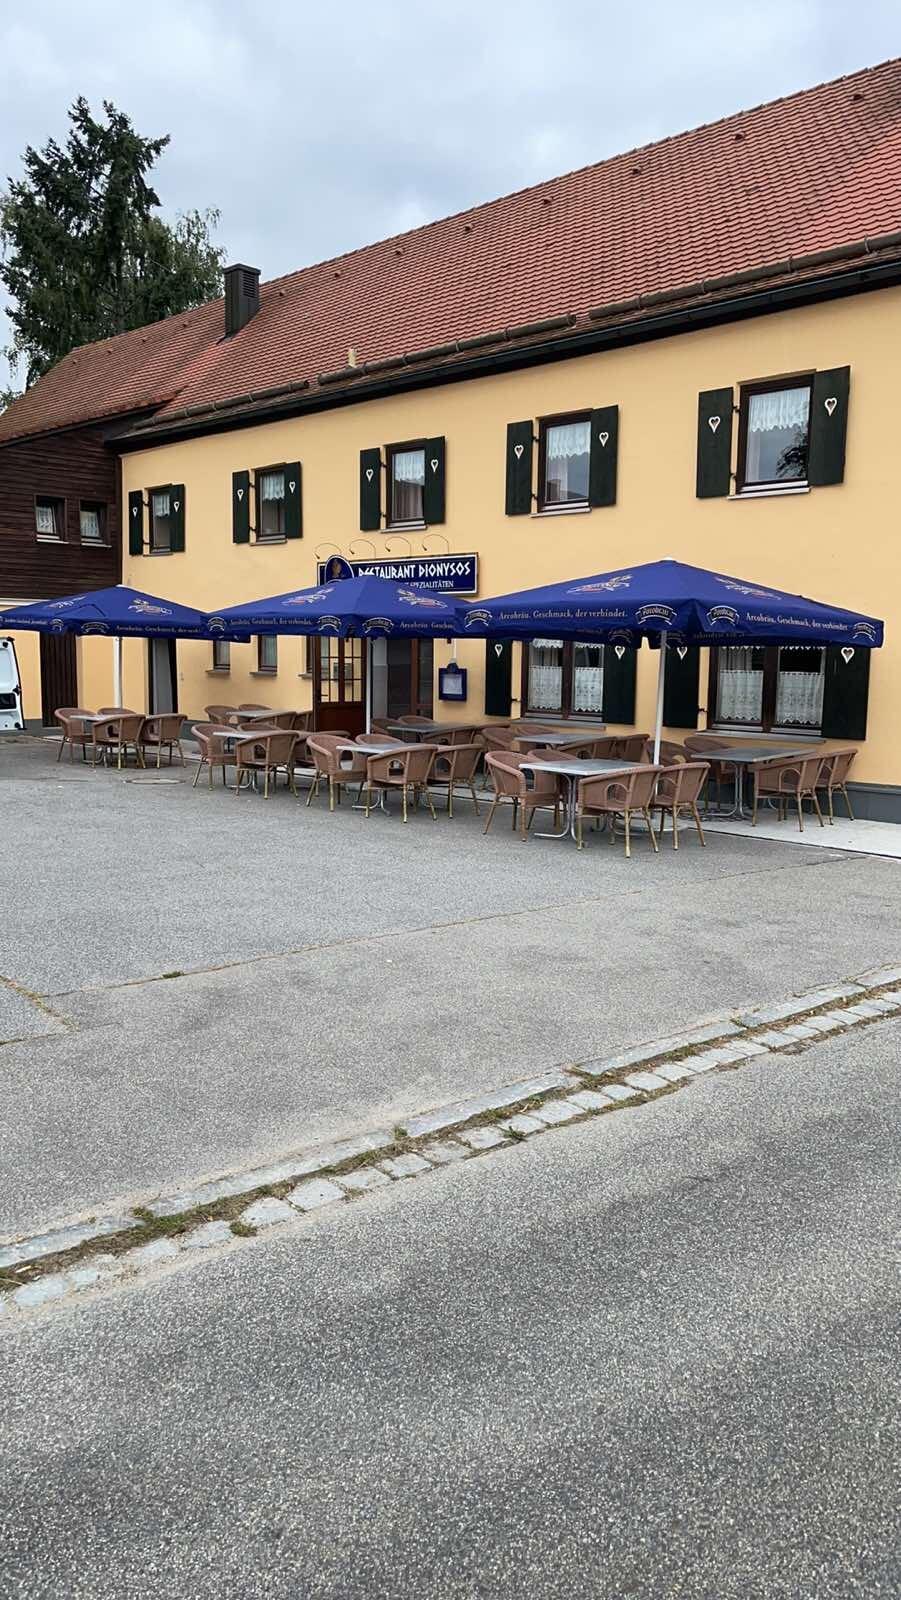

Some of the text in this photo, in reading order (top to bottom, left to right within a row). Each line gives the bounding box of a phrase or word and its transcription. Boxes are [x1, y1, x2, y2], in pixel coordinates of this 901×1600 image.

[358, 561, 471, 579] RESTAURANT DIONYSOS
[532, 609, 574, 618] Geschmack,
[575, 609, 588, 617] der
[588, 608, 628, 617] verbindet.
[811, 620, 821, 628] der
